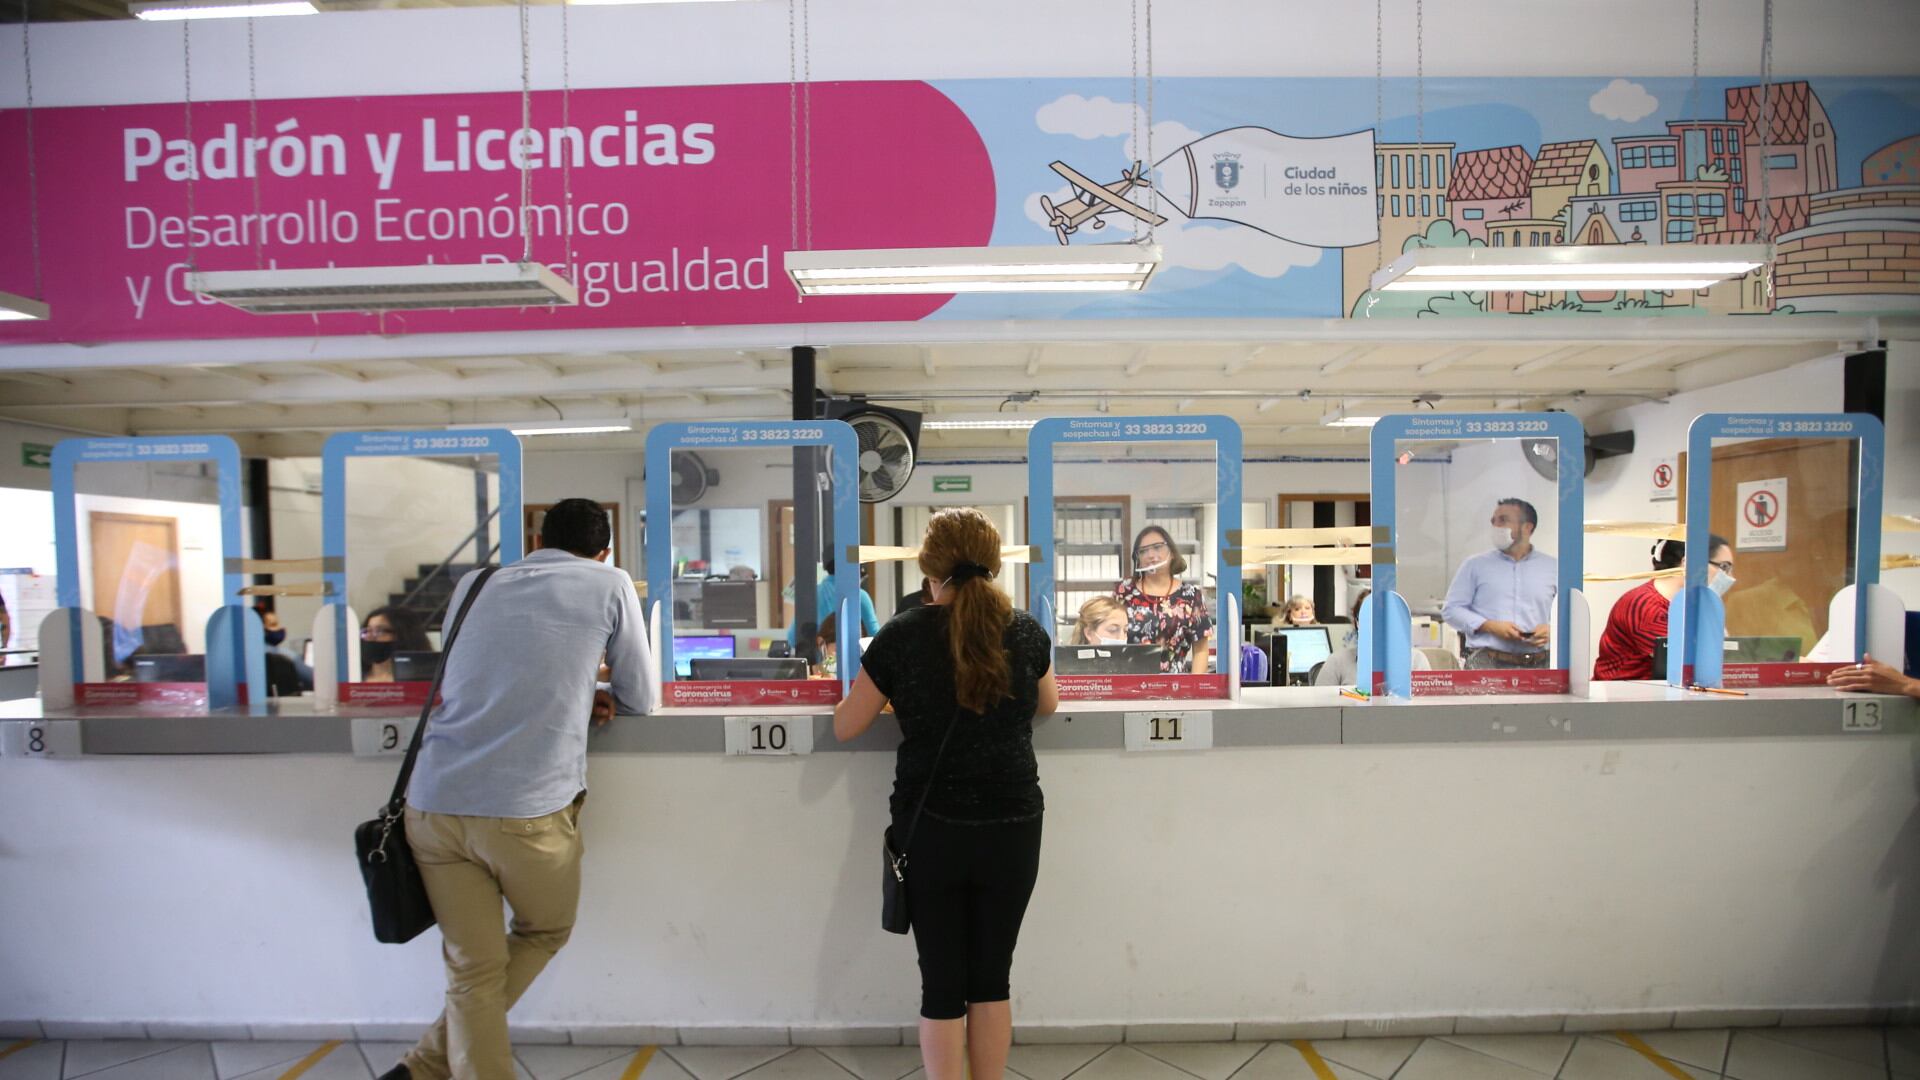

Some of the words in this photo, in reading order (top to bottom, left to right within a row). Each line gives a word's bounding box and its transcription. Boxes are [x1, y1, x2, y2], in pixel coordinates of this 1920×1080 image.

[123, 117, 347, 182] Padrón
[364, 133, 402, 190] y
[422, 109, 716, 172] Licencias
[1284, 166, 1336, 179] Ciudad
[1284, 183, 1302, 195] de
[1305, 183, 1326, 195] los
[1328, 182, 1368, 195] niños
[1208, 199, 1247, 208] Zapopan
[125, 199, 359, 249] Desarrollo
[375, 193, 629, 241] Económico
[125, 275, 151, 320] y
[1125, 424, 1140, 435] 33
[1142, 424, 1174, 434] 3823
[1176, 423, 1207, 434] 3220
[1405, 427, 1450, 436] sospechas
[1452, 426, 1462, 435] al
[1466, 422, 1482, 433] 33
[1484, 422, 1514, 432] 3823
[1516, 421, 1548, 431] 3220
[1778, 422, 1792, 432] 33
[1794, 422, 1822, 432] 3823
[1824, 421, 1853, 432] 3220
[742, 430, 758, 441] 33
[760, 429, 790, 440] 3823
[792, 428, 824, 440] 3220
[1063, 429, 1110, 439] sospechas
[1111, 429, 1120, 437] al
[412, 438, 428, 449] 33
[430, 437, 458, 449] 3823
[460, 436, 489, 448] 3220
[1846, 702, 1879, 728] 13
[1150, 718, 1182, 740] 11
[29, 727, 45, 752] 8
[752, 724, 786, 750] 10
